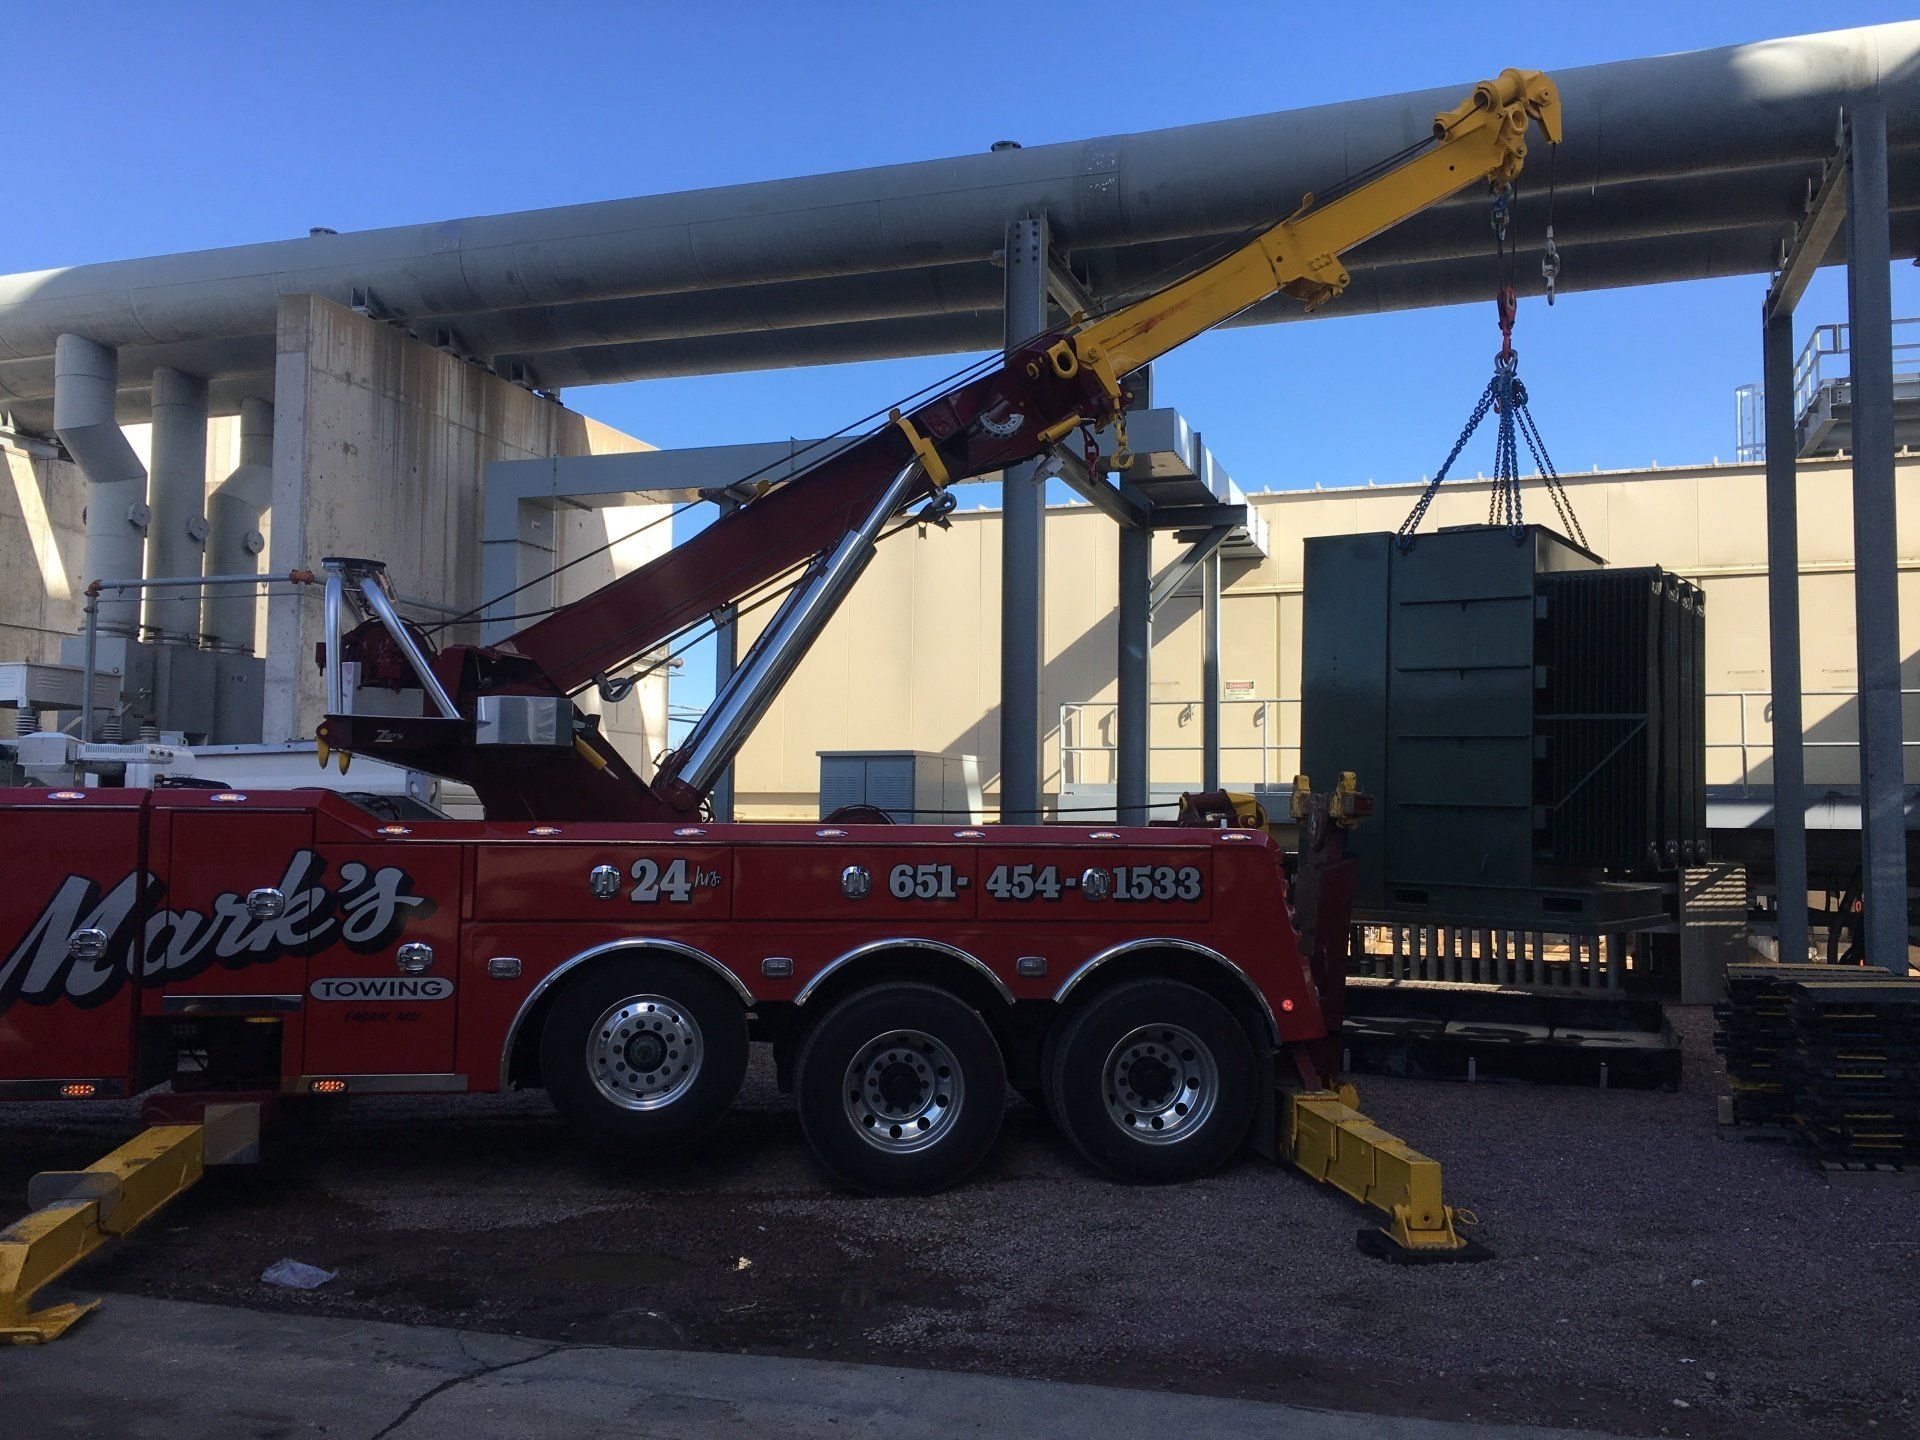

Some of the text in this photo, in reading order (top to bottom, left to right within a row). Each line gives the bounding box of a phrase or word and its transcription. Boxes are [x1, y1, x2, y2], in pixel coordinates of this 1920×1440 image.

[630, 858, 691, 901] 24
[889, 863, 968, 898] 651-
[1112, 866, 1200, 899] 1533
[0, 850, 424, 996] Mark's
[321, 981, 443, 997] TOWING
